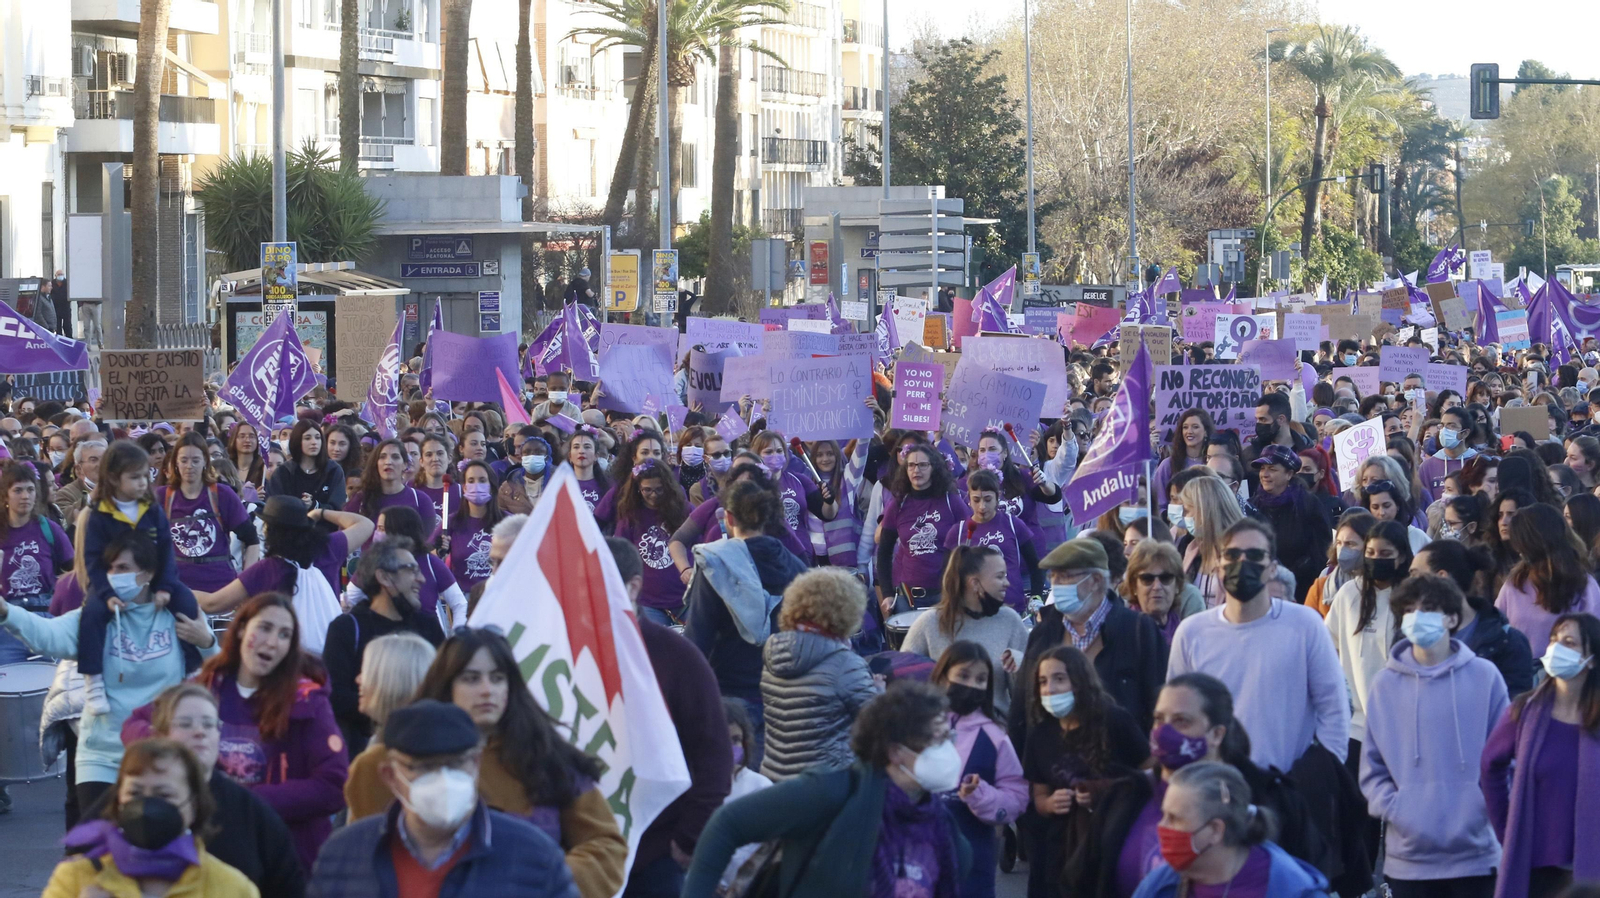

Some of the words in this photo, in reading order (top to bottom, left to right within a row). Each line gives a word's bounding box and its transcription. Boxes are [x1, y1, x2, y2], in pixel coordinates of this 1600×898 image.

[265, 246, 292, 254] DINO
[412, 238, 422, 250] P
[265, 254, 292, 263] EXPO
[420, 266, 462, 275] ENTRADA
[615, 290, 627, 307] P
[1083, 292, 1108, 301] REBELDE
[340, 297, 385, 315] VAMOS
[343, 314, 385, 333] TODAS
[341, 333, 349, 348] A
[352, 332, 388, 348] VOLAR
[848, 334, 862, 343] HACE
[866, 334, 876, 342] UN
[855, 342, 867, 351] COMO
[341, 348, 375, 366] SOBRE
[440, 341, 473, 360] OTRO
[968, 342, 1046, 364] AGRADECER
[106, 353, 151, 368] DONDE
[1027, 365, 1041, 373] todo
[108, 371, 123, 385] EL
[770, 366, 785, 385] LO
[790, 365, 843, 384] CONTRARIO
[845, 360, 865, 379] AL
[905, 369, 918, 377] YO
[919, 370, 933, 378] NO
[1160, 369, 1185, 391] NO
[903, 379, 921, 388] SOY
[922, 381, 935, 389] UN
[955, 366, 971, 385] DE
[979, 374, 1033, 402] CAMINO
[104, 385, 129, 404] HOY
[134, 385, 170, 402] GRITA
[174, 384, 192, 398] LA
[773, 382, 848, 412] FEMINISMO
[1167, 389, 1261, 410] AUTORIDAD
[114, 401, 165, 420] RABIA
[919, 402, 932, 411] ME
[947, 399, 968, 419] SER
[996, 401, 1031, 422] QUIERO
[783, 404, 863, 435] IGNORANCIA
[902, 414, 931, 423] SILBES!
[944, 420, 974, 446] IBRE,
